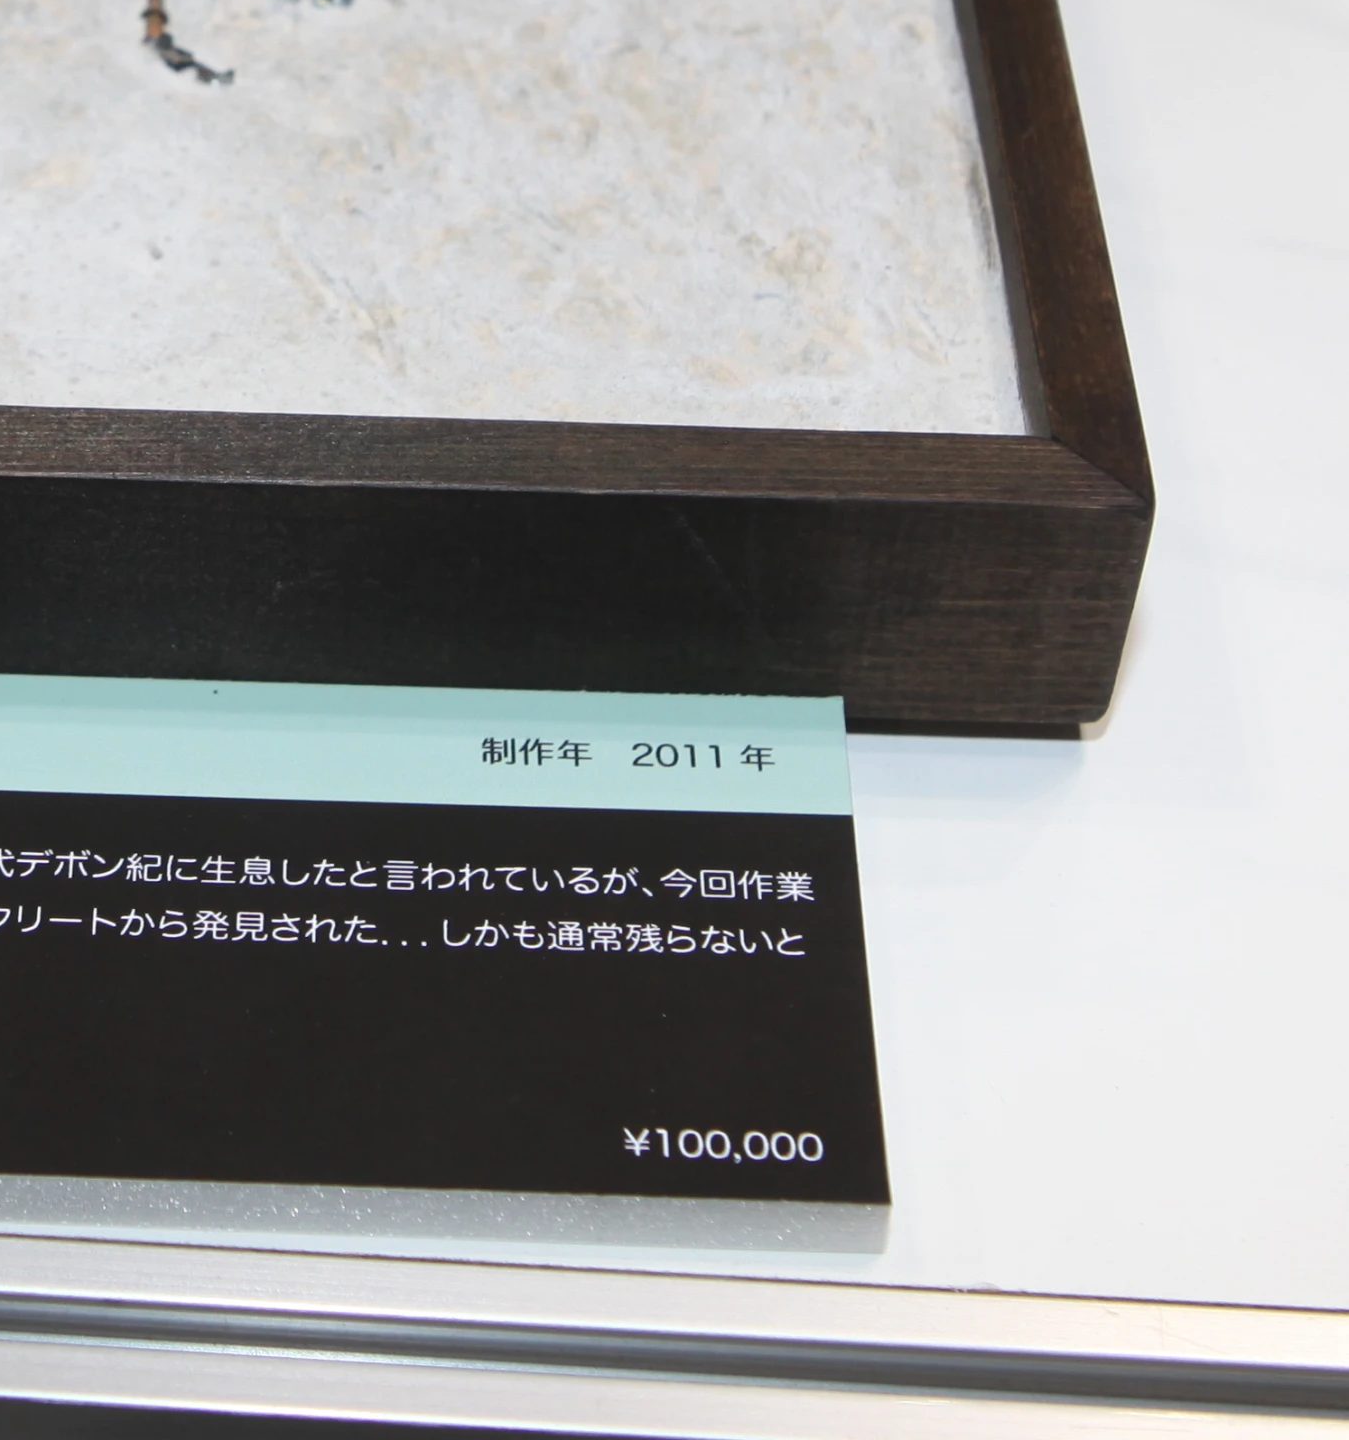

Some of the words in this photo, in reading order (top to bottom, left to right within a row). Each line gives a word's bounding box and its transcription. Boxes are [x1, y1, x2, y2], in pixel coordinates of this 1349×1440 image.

[482, 737, 592, 767] 制作年
[623, 1127, 824, 1164] ¥100,000
